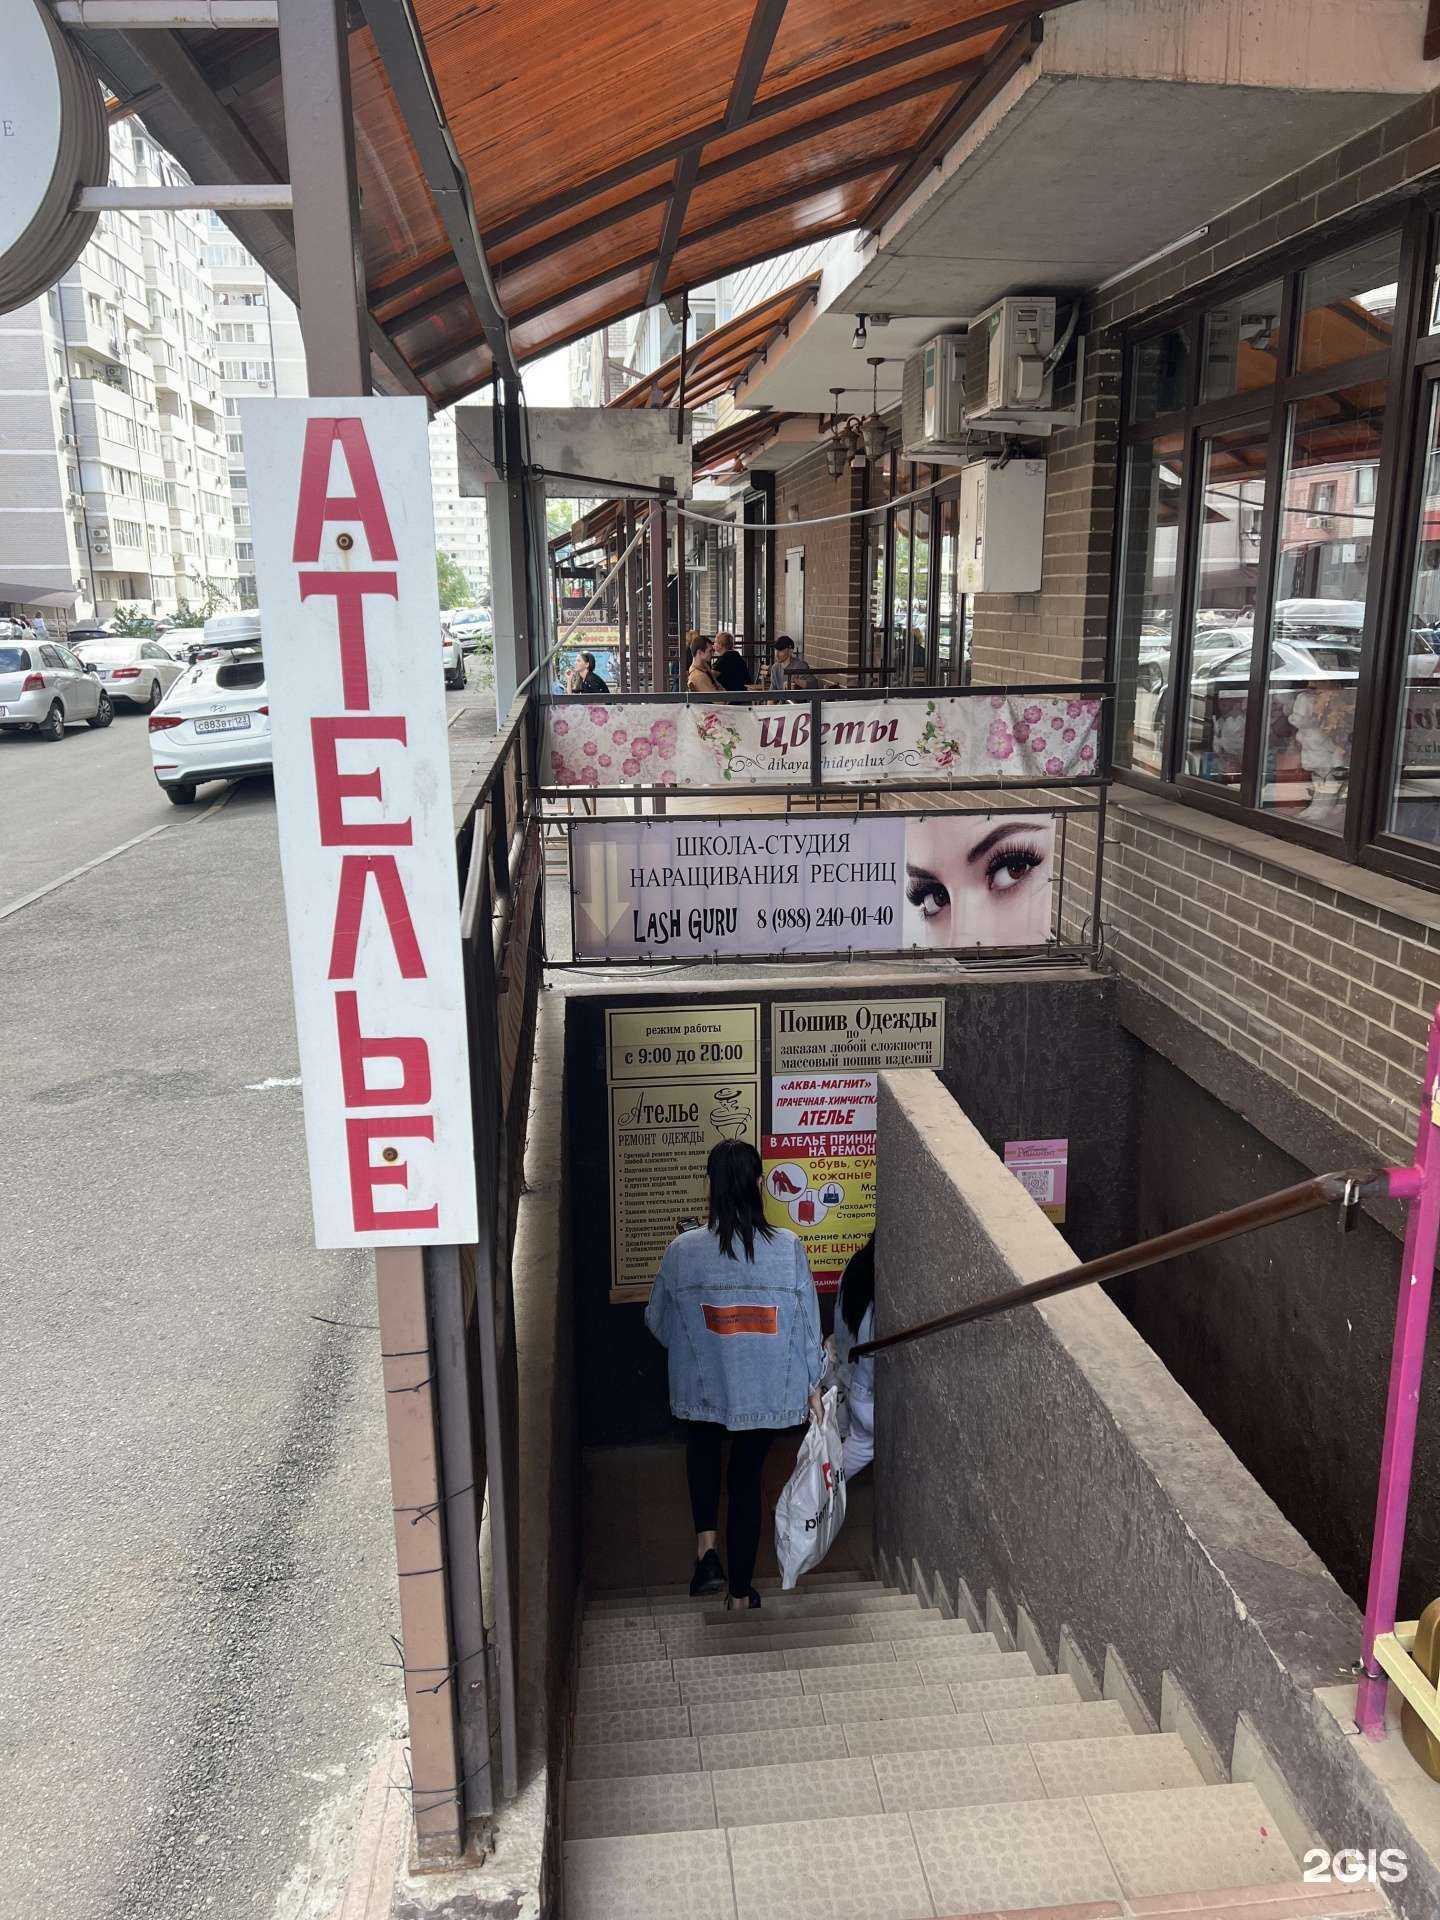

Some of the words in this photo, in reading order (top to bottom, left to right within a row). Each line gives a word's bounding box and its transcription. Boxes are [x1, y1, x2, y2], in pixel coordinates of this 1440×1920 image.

[292, 417, 439, 1232] АТЕЛЬЕ
[676, 833, 851, 858] ШКОЛА-СТУДИЯ
[630, 864, 799, 889] НАРАЩИВАНИЯ
[811, 862, 897, 885] РЕСНИЦ
[757, 909, 767, 929] 8
[772, 907, 811, 932] (988)
[815, 905, 894, 928] 240-01-40
[778, 1009, 848, 1033] Пошив
[855, 1006, 937, 1035] Одежды
[646, 1026, 683, 1037] режим
[684, 1024, 722, 1036] работы
[846, 1030, 859, 1039] по
[624, 1052, 634, 1064] с
[638, 1047, 671, 1064] 9:00
[675, 1050, 696, 1065] до
[700, 1043, 743, 1062] 20:00
[780, 1043, 826, 1056] заказам
[830, 1038, 867, 1053] любой
[870, 1040, 933, 1052] сложности
[781, 1053, 838, 1069] массовый
[843, 1054, 881, 1067] пошив
[885, 1051, 933, 1066] изделий
[780, 1078, 872, 1091] «АКВА-МАГНИТ»
[617, 1091, 699, 1126] Ателье
[798, 1109, 856, 1127] АТЕЛЬЕ
[618, 1132, 657, 1147] РЕМОНТ
[662, 1130, 705, 1147] ОДЕЖДЫ
[770, 1137, 778, 1148] В
[781, 1135, 826, 1147] АТЕЛЬЕ
[808, 1146, 827, 1157] НА
[809, 1158, 850, 1170] обувь,
[812, 1171, 872, 1182] кожаные
[805, 1243, 829, 1254] КИЕ
